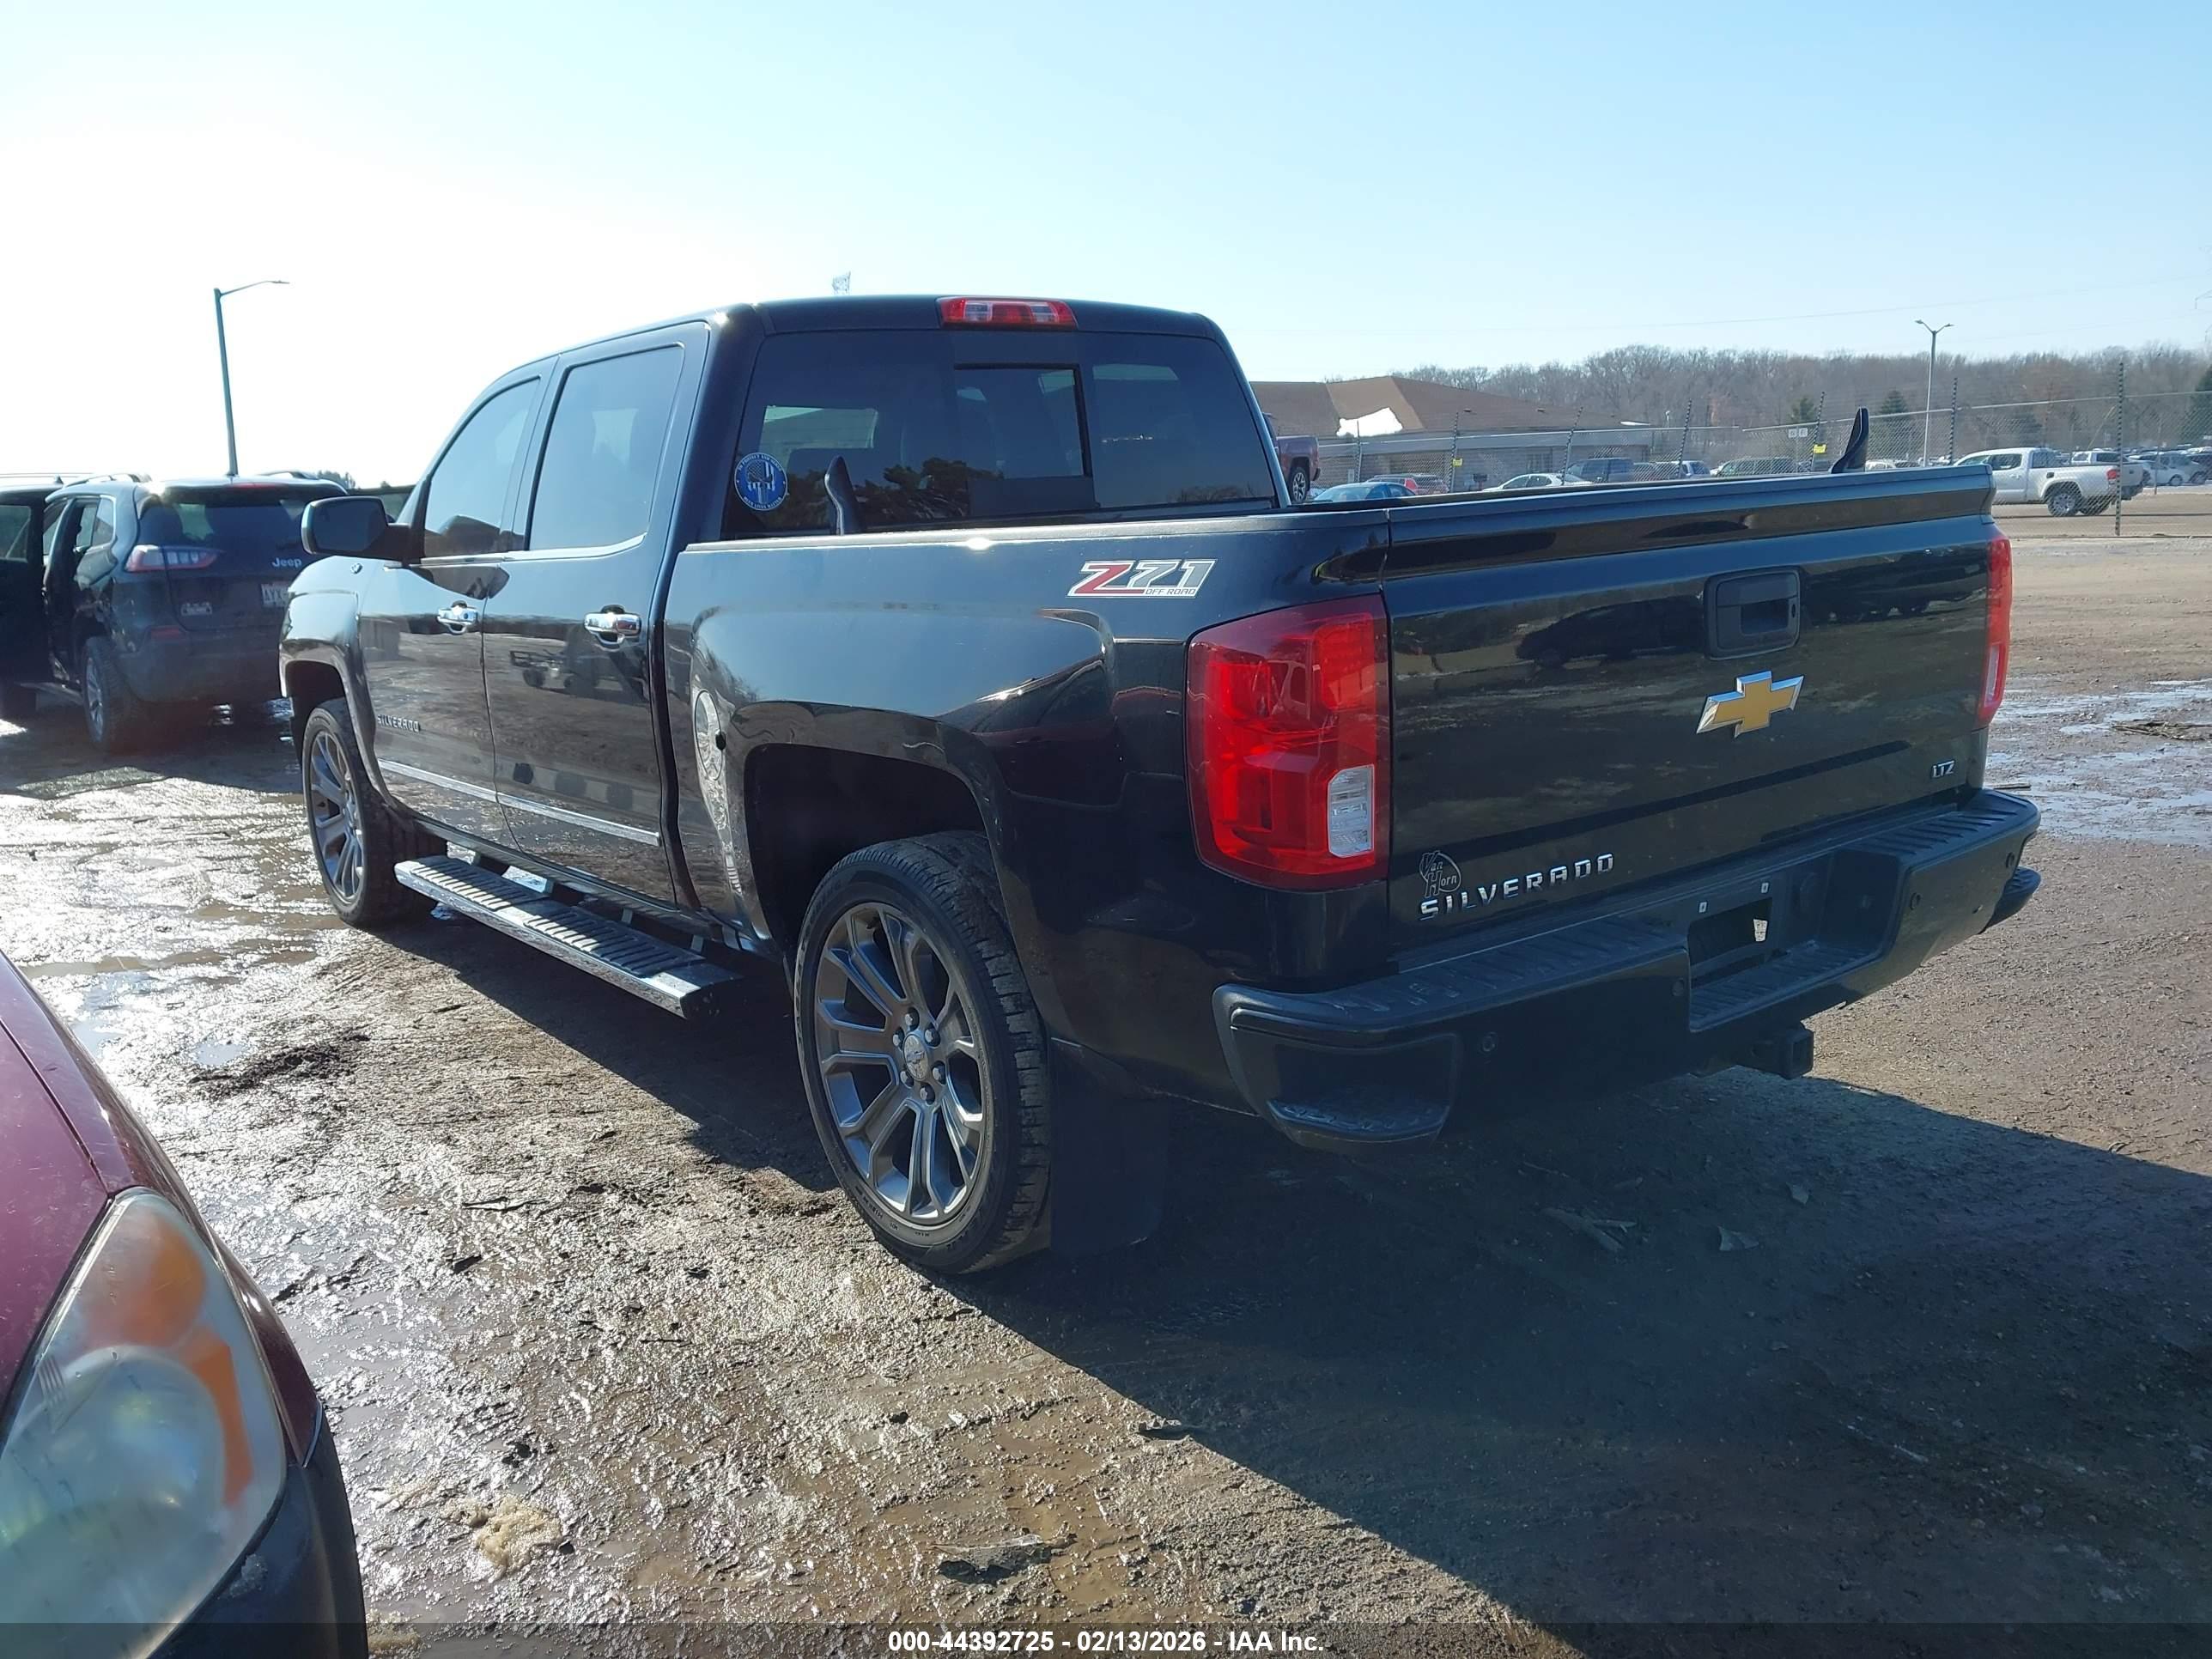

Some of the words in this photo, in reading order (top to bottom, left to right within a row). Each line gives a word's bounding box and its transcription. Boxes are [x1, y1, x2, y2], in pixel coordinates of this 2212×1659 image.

[271, 557, 302, 568] Jeep
[1066, 559, 1218, 598] Z71
[377, 714, 420, 732] SILVERADO
[1932, 760, 1955, 778] LTZ
[1421, 850, 1443, 876] Van
[1419, 853, 1613, 921] SILVERADO
[1425, 869, 1458, 899] Horn
